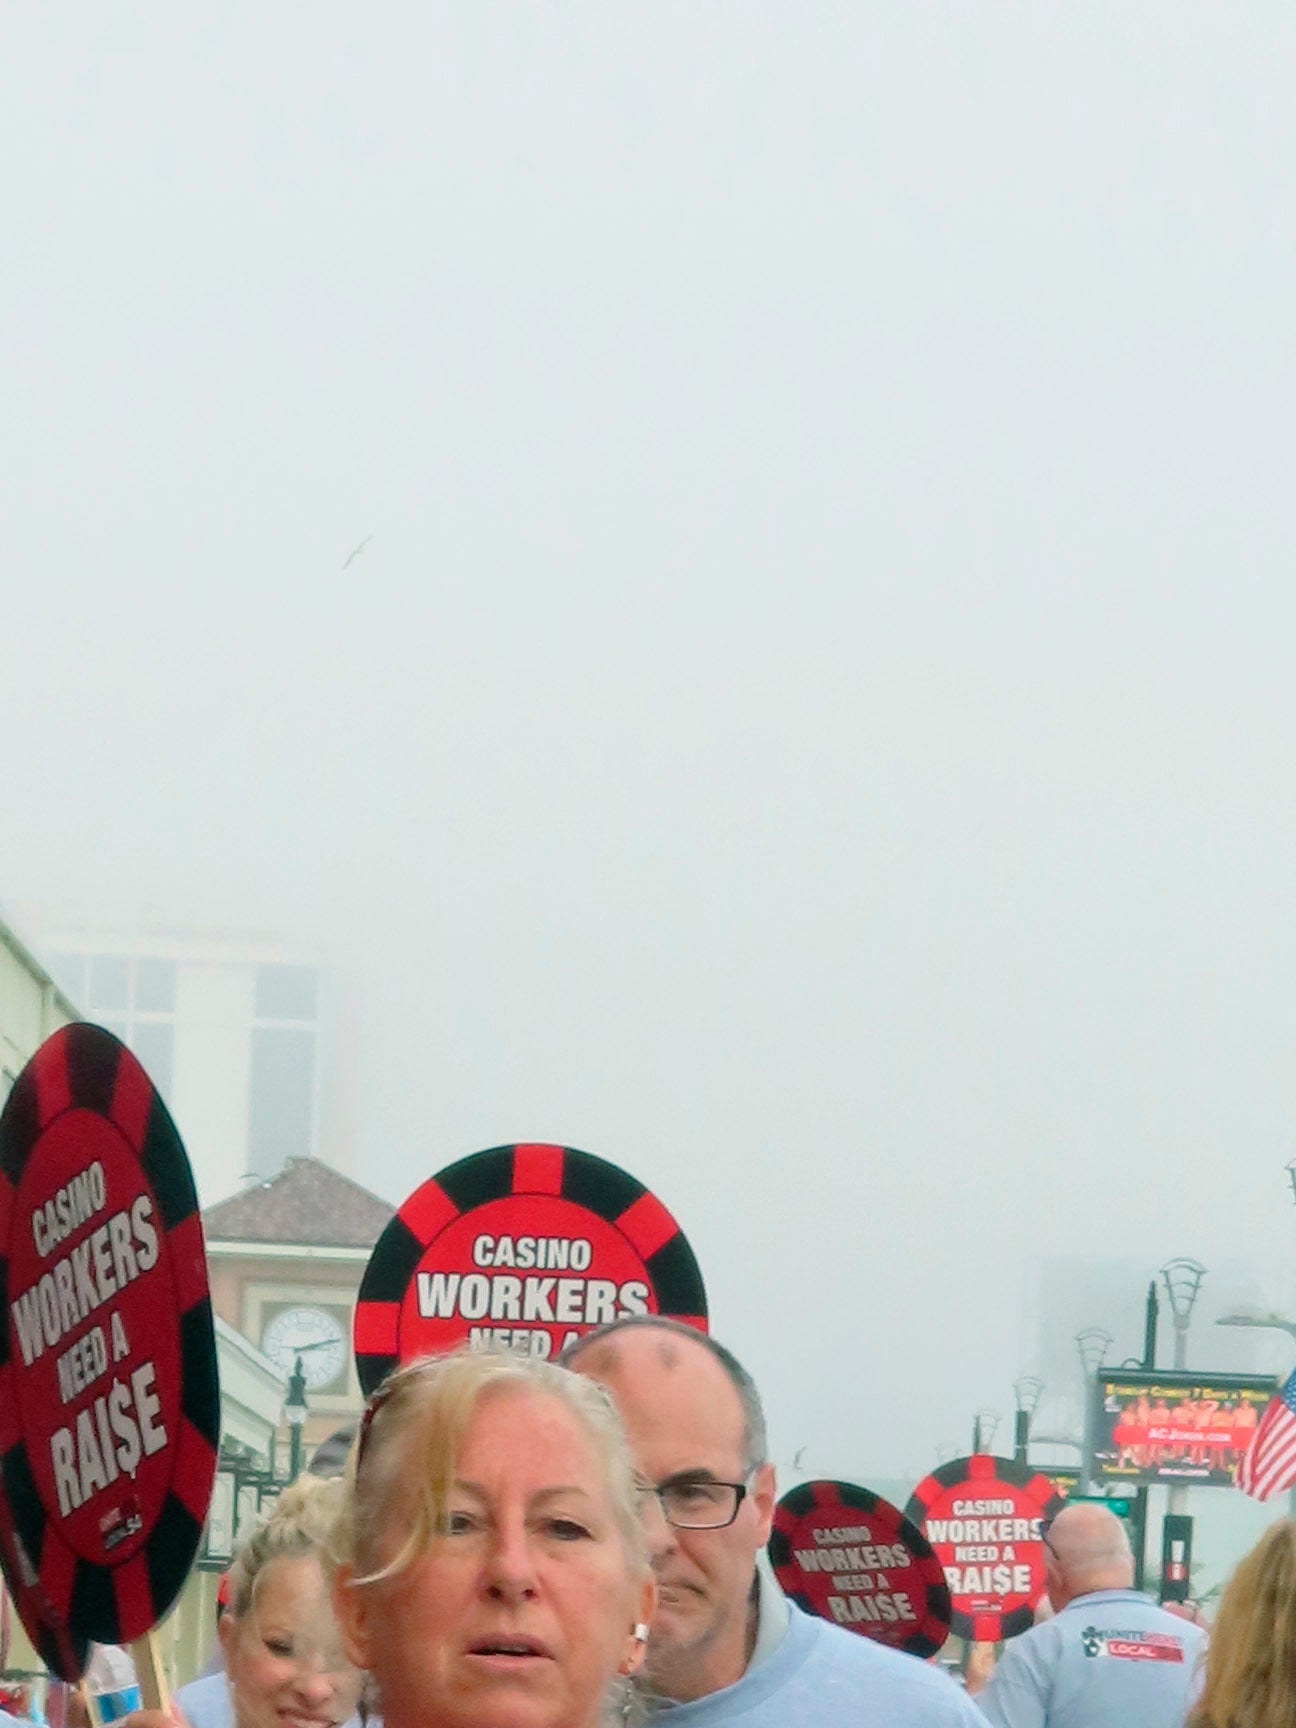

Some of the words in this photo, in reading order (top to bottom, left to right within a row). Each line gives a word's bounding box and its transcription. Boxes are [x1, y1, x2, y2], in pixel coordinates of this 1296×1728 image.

[31, 1160, 106, 1257] CASINO
[473, 1234, 591, 1271] CASINO
[12, 1192, 159, 1366] WORKERS
[416, 1272, 650, 1323] WORKERS
[57, 1332, 105, 1405] NEED
[112, 1312, 130, 1358] A
[50, 1361, 166, 1518] RAI$E
[952, 1498, 1015, 1516] CASINO
[812, 1525, 872, 1545] CASINO
[926, 1518, 1045, 1543] WORKERS
[793, 1543, 911, 1572] WORKERS
[955, 1546, 999, 1562] NEED
[1002, 1545, 1015, 1561] A
[832, 1574, 874, 1591] NEED
[876, 1573, 890, 1590] A
[943, 1563, 1032, 1596] RAI$E
[1109, 1644, 1156, 1657] LOCAL
